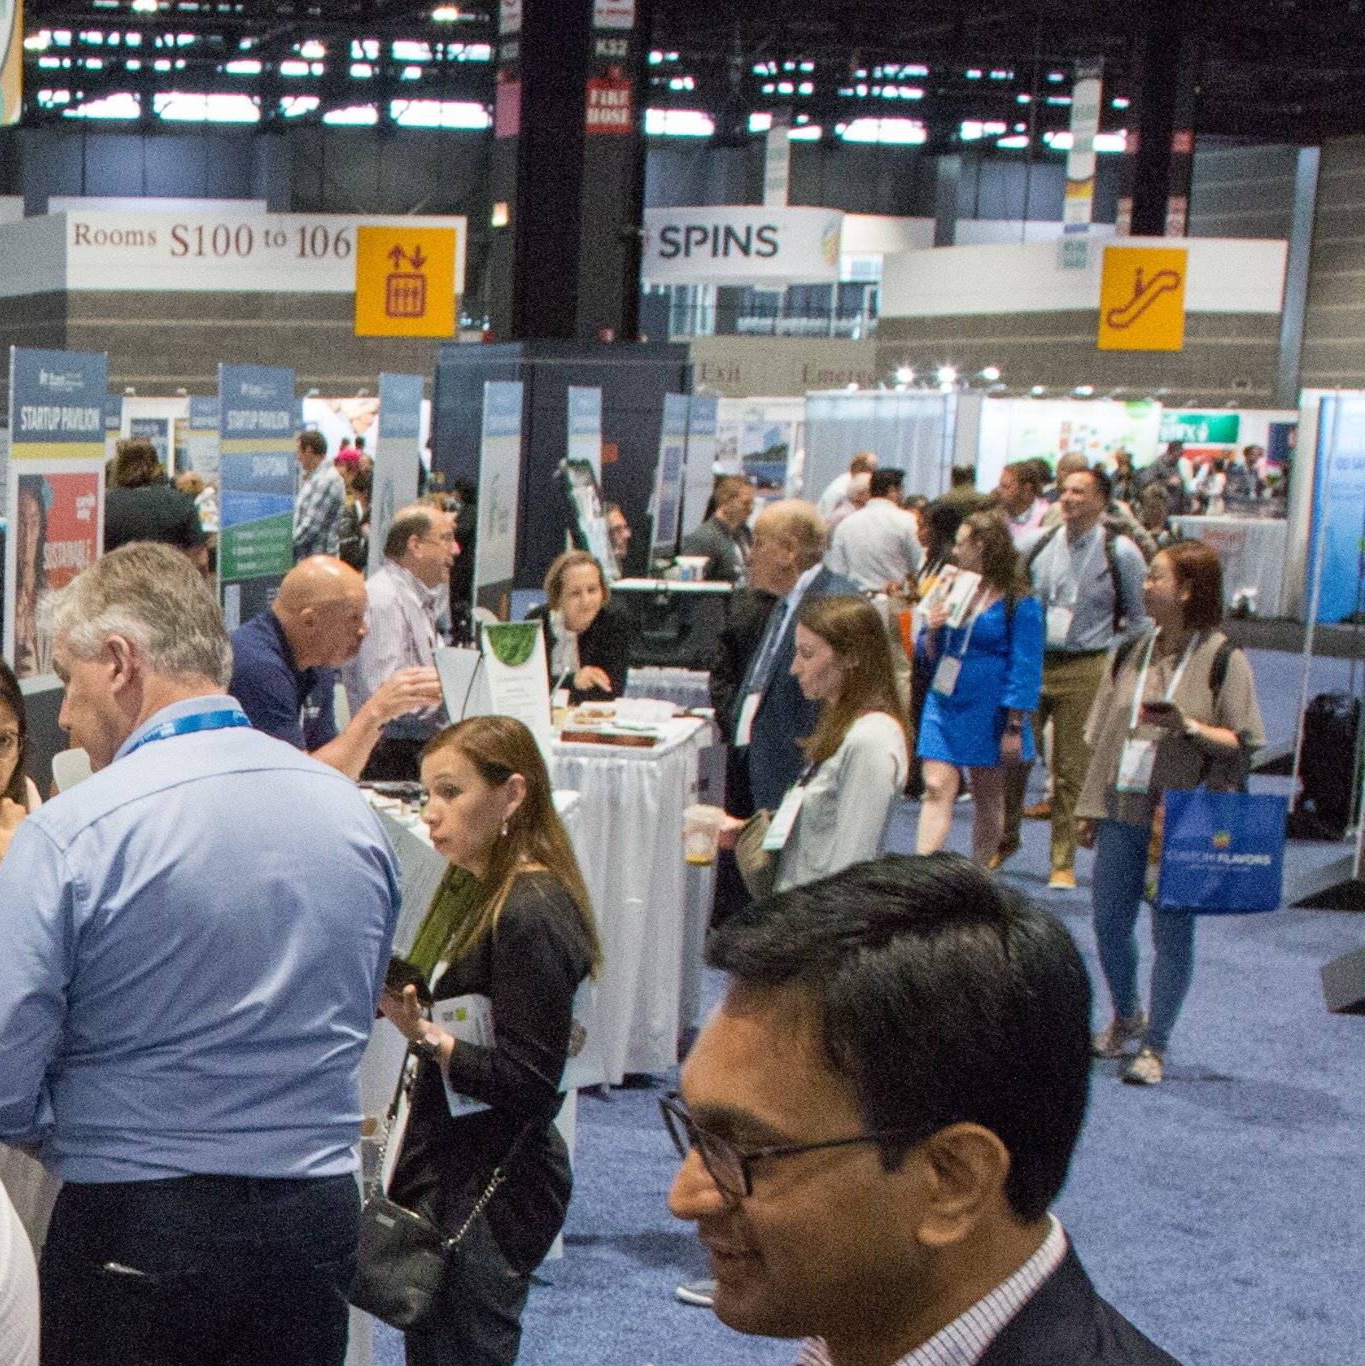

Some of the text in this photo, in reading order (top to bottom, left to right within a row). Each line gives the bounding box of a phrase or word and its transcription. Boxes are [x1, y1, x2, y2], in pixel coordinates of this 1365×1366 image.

[591, 89, 630, 105] FIRE
[587, 107, 628, 124] HOSE
[74, 224, 351, 259] Rooms S100 to 106
[658, 224, 778, 259] SPINS
[20, 406, 100, 432] STARTUP PAVILION
